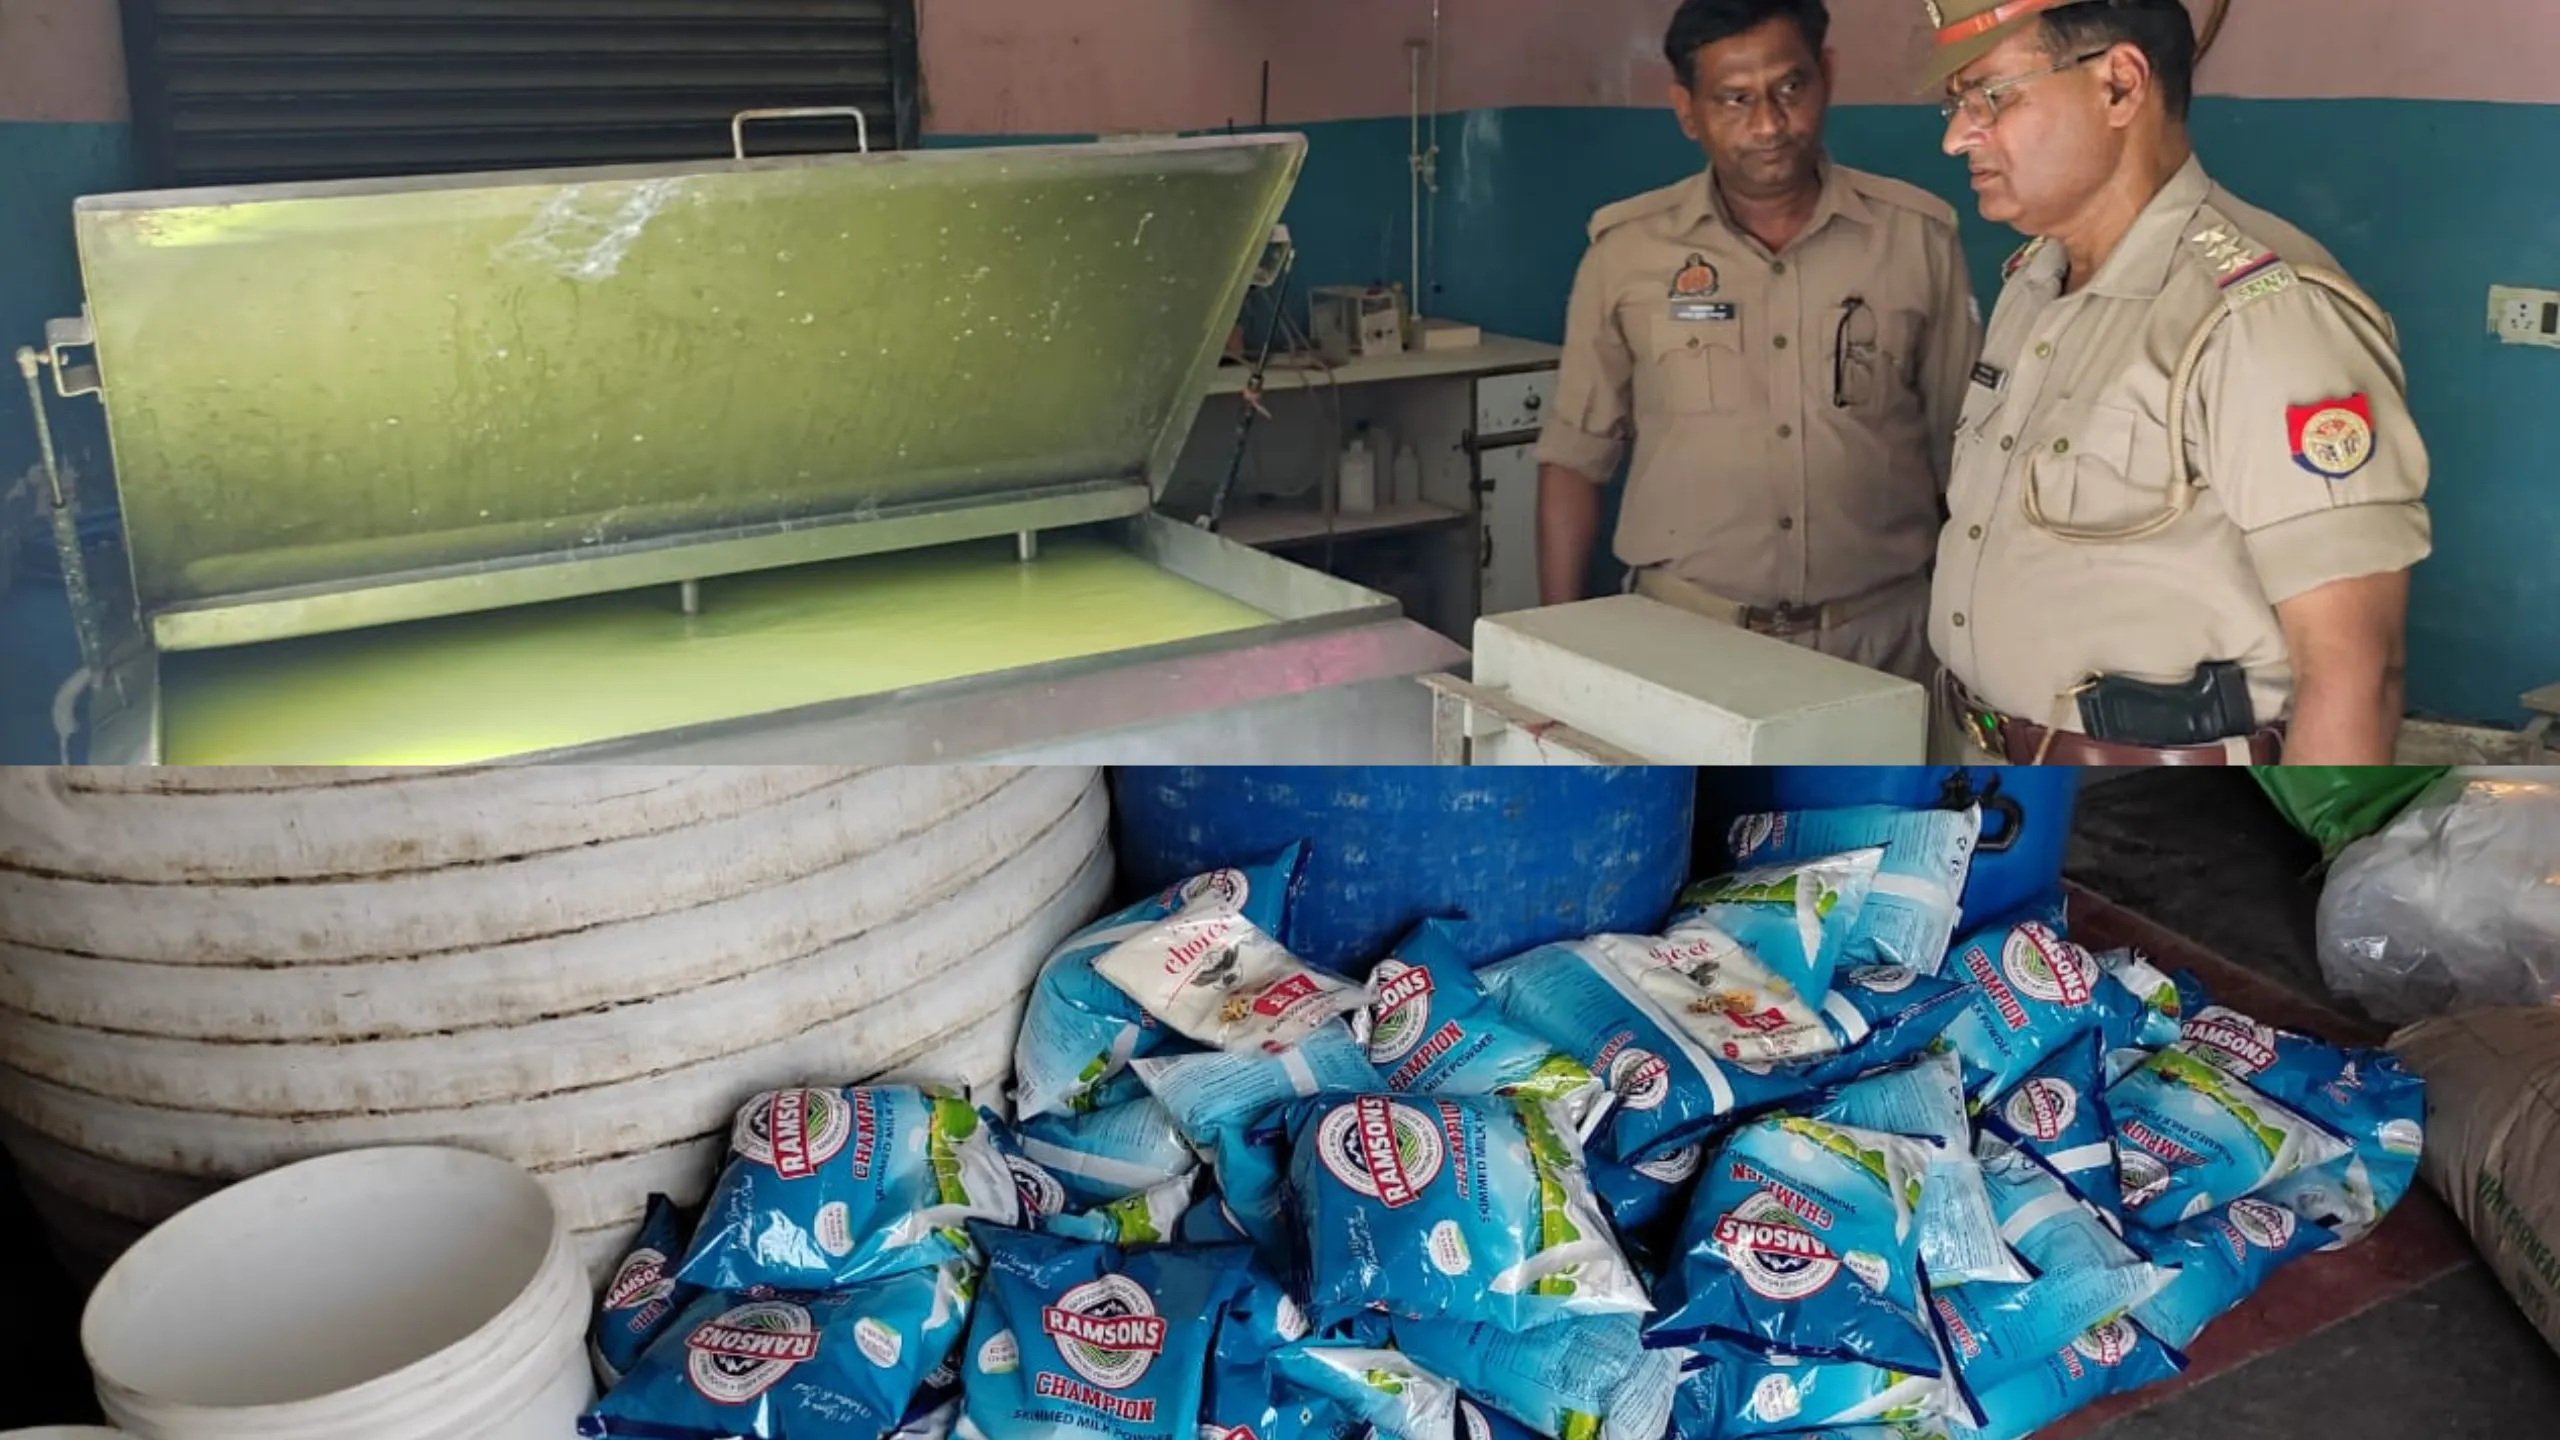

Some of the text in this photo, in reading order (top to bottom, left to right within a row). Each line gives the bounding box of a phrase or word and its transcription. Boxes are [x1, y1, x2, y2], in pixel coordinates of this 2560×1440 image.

[1963, 947, 2030, 1032] CHAMPION
[1387, 1020, 1465, 1092] HAMPION
[1423, 1032, 1497, 1092] MILK POWDER
[780, 1088, 807, 1173] RAMSO
[853, 1089, 874, 1178] CHAMPI
[1360, 1099, 1408, 1201] RAMSONS
[1722, 1220, 1829, 1256] AMSONS
[698, 1325, 811, 1357] RAMSONS
[1050, 1311, 1159, 1345] RAMSONS
[1013, 1408, 1074, 1426] SKIMMED
[1076, 1414, 1110, 1433] MILK
[1037, 1374, 1155, 1421] CHAMPION
